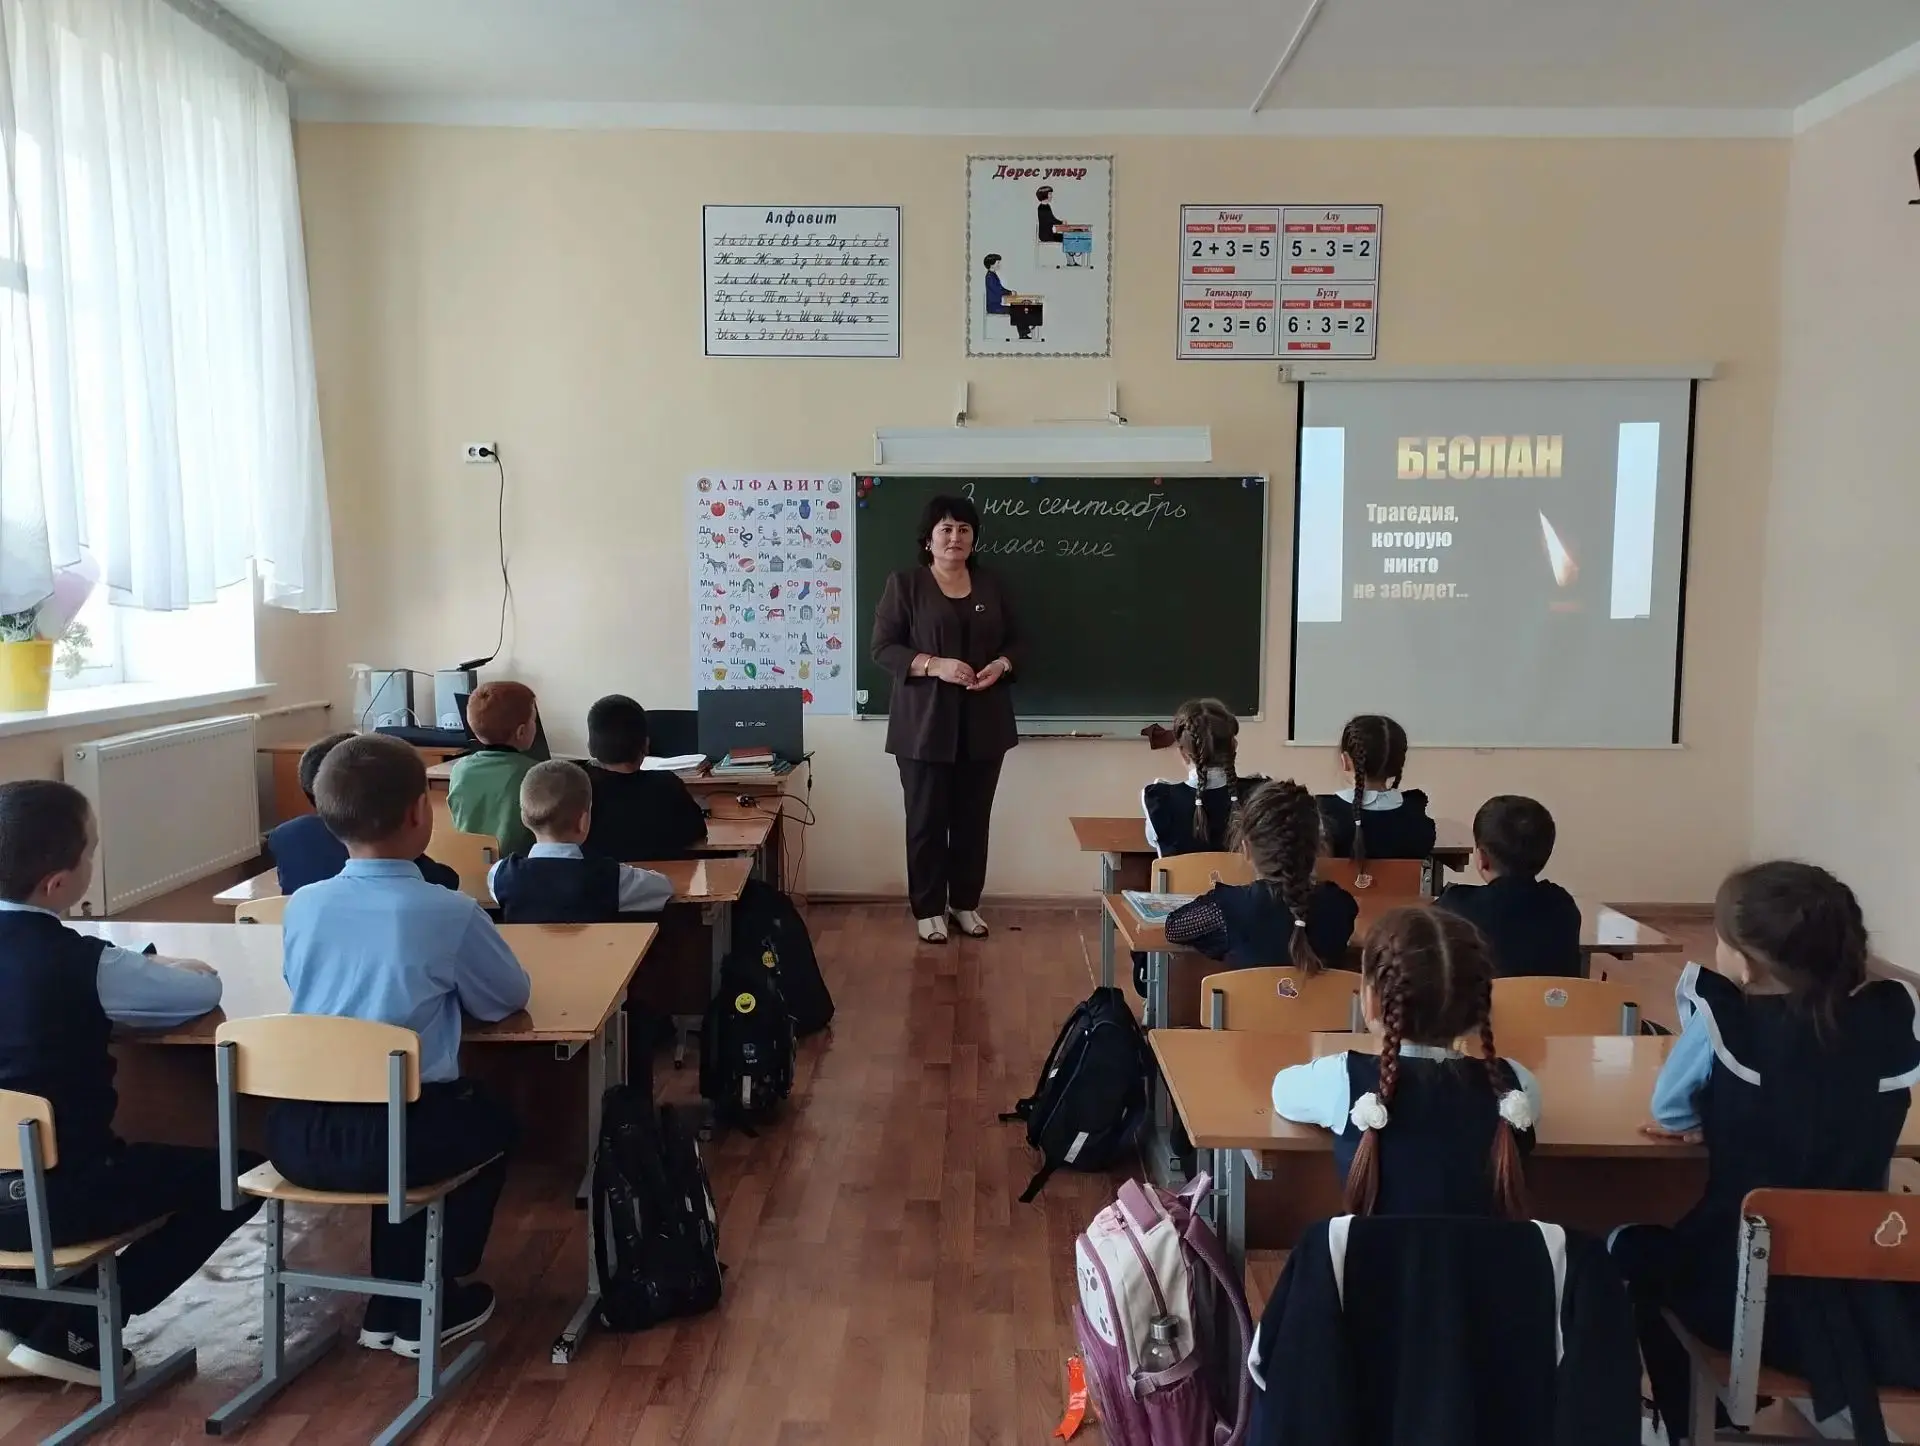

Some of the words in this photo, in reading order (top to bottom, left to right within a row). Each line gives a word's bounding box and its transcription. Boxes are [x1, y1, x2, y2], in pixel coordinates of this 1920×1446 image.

[992, 165, 1040, 180] Дөрес
[1042, 168, 1088, 180] утыр
[765, 210, 837, 228] Алфавит
[1323, 211, 1341, 222] Алу
[1192, 240, 1202, 257] 2
[1209, 242, 1219, 255] +
[1226, 240, 1236, 257] 3
[1242, 244, 1253, 253] =
[1259, 240, 1270, 257] 5
[1292, 240, 1302, 257] 5
[1326, 240, 1336, 257] 3
[1342, 244, 1354, 253] =
[1359, 240, 1370, 257] 2
[1204, 288, 1253, 299] Тапкырлау
[1190, 316, 1200, 333] 2
[1223, 316, 1233, 333] 3
[1239, 321, 1250, 329] =
[1256, 316, 1267, 333] 6
[1288, 316, 1298, 333] 6
[1321, 316, 1331, 333] 3
[1338, 321, 1348, 329] =
[1354, 316, 1365, 333] 2
[1397, 434, 1563, 480] БЕСЛАН
[717, 479, 824, 491] АЛФАВИТ
[983, 498, 1030, 516] нче
[1039, 492, 1187, 531] сентябрь
[1366, 503, 1459, 524] Трагедия,
[1371, 531, 1453, 550] которую
[1383, 557, 1439, 573] никто
[1353, 583, 1376, 599] не
[1380, 580, 1469, 600] забудет...
